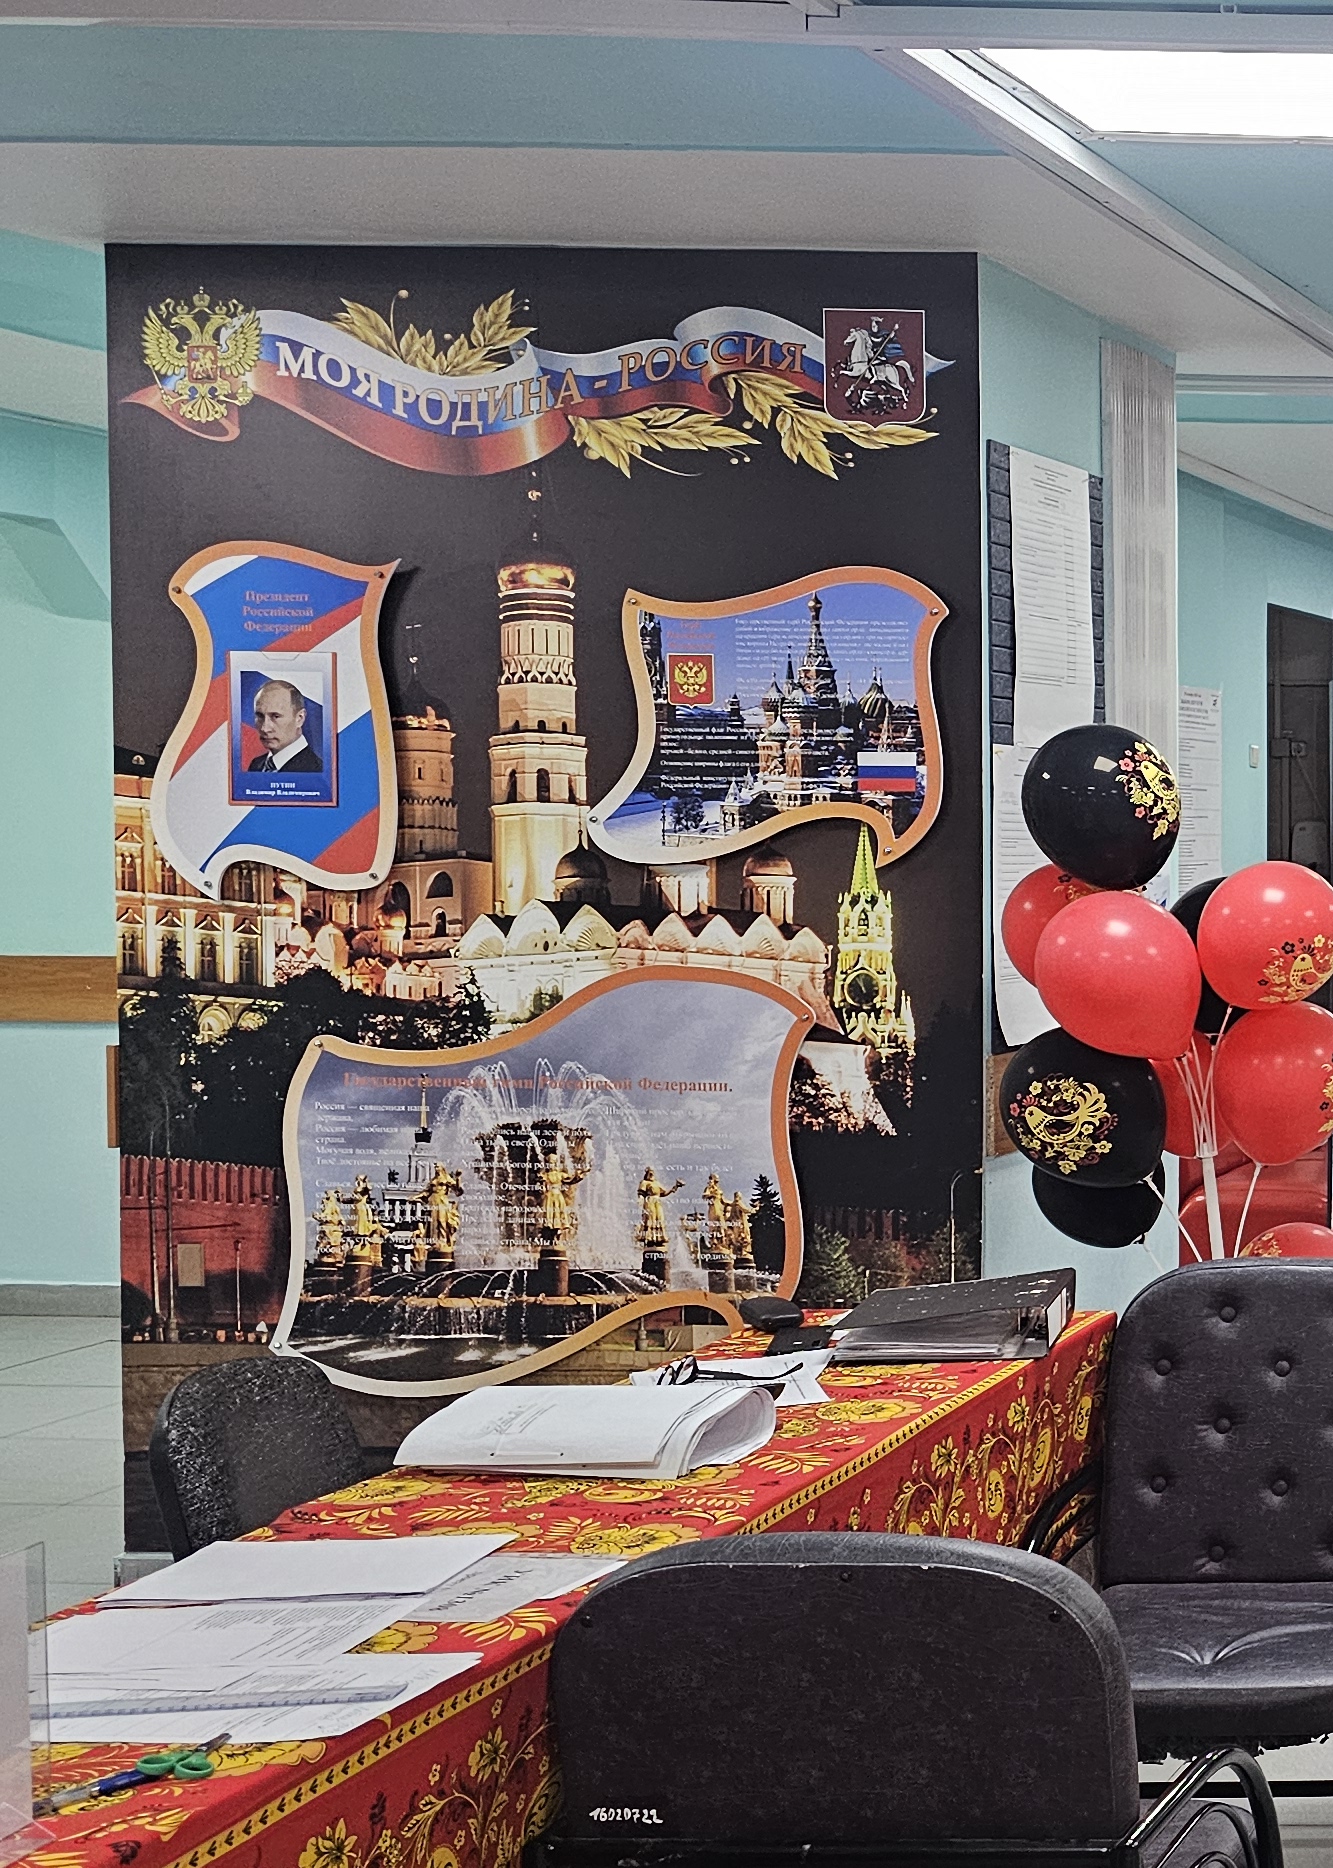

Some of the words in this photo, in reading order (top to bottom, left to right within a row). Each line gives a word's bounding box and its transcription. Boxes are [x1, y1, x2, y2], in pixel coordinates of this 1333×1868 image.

[275, 341, 381, 408] МОЯ
[392, 368, 584, 435] РОДИНА
[617, 337, 807, 391] РОССИЯ
